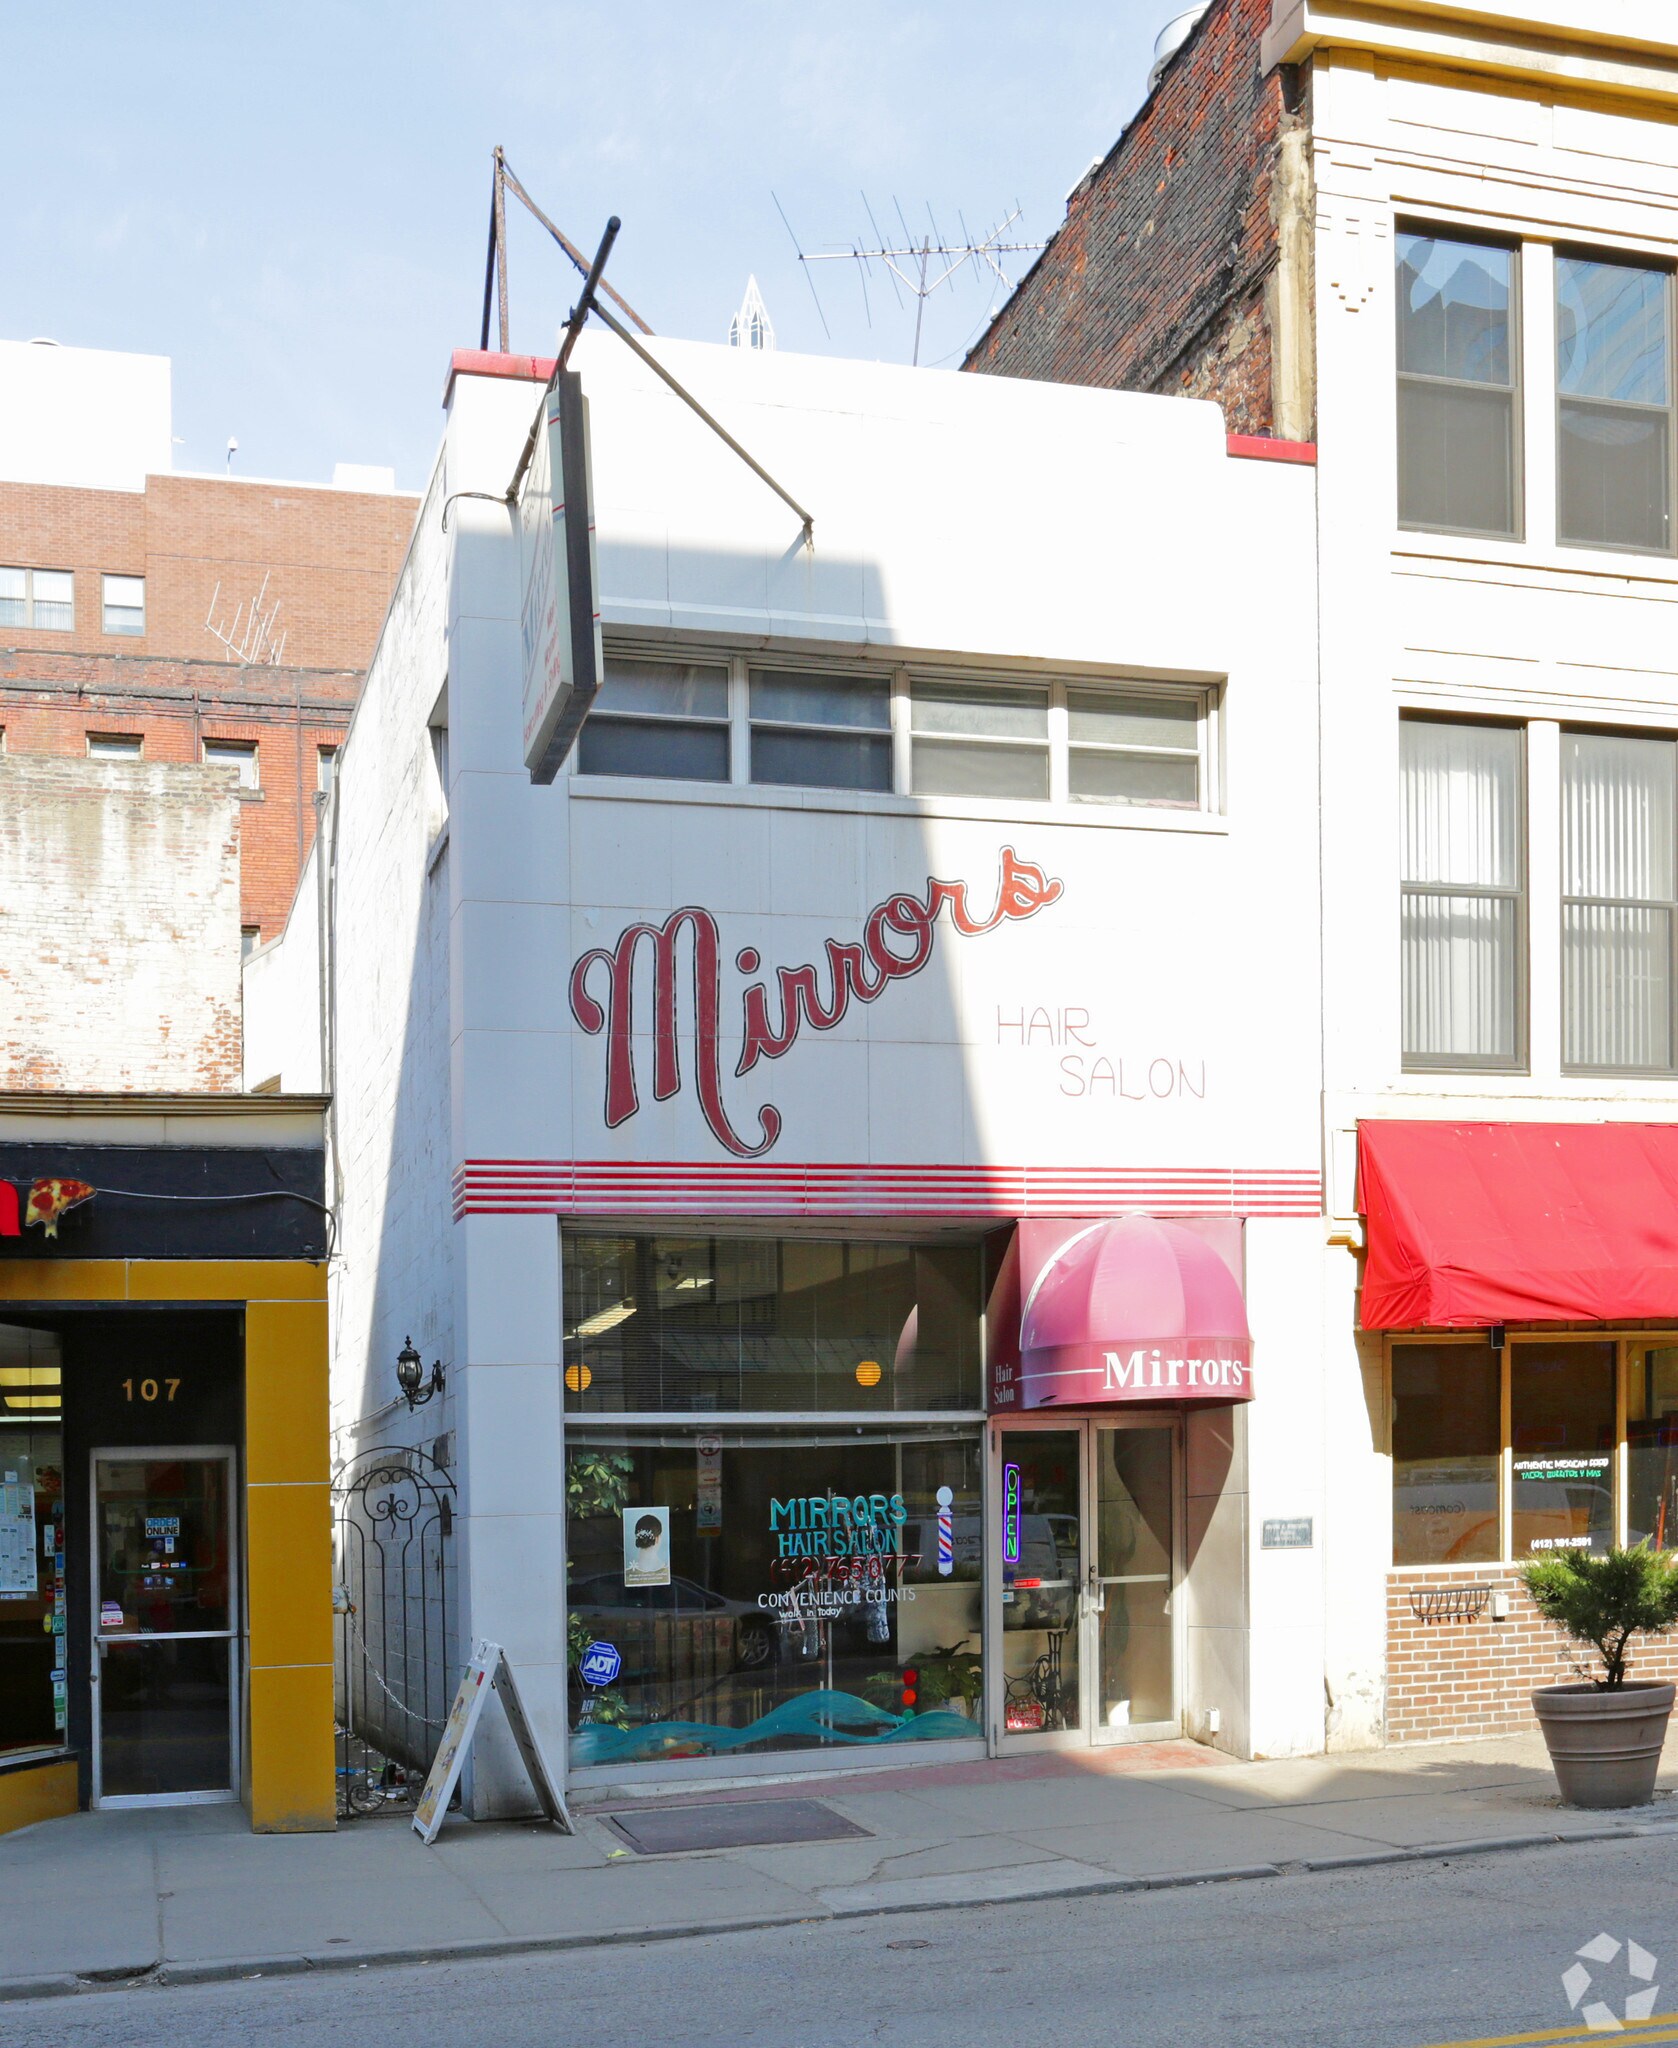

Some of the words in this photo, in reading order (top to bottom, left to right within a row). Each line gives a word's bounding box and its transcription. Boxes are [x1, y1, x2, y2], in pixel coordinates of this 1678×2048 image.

[569, 845, 1064, 1159] Mirrors
[997, 1005, 1096, 1047] HAIR
[1059, 1055, 1206, 1100] SALON
[995, 1363, 1013, 1384] Hair
[1102, 1349, 1244, 1390] Mirrors
[122, 1378, 181, 1402] 107
[994, 1386, 1015, 1405] Salon
[1513, 1460, 1554, 1470] AUTHENTIC
[1554, 1459, 1588, 1469] MEXICAN
[1579, 1469, 1585, 1478] Y
[146, 1518, 178, 1527] ORDER
[769, 1494, 908, 1531] MIRRORS
[1007, 1469, 1018, 1557] OPEN
[146, 1526, 179, 1536] ONLINE
[778, 1531, 832, 1558] HAIR
[833, 1529, 898, 1555] SALON
[1530, 1538, 1553, 1550] (412)
[758, 1590, 861, 1608] CONVENIENCE
[865, 1587, 916, 1604] COUNTS
[584, 1655, 616, 1674] ADT
